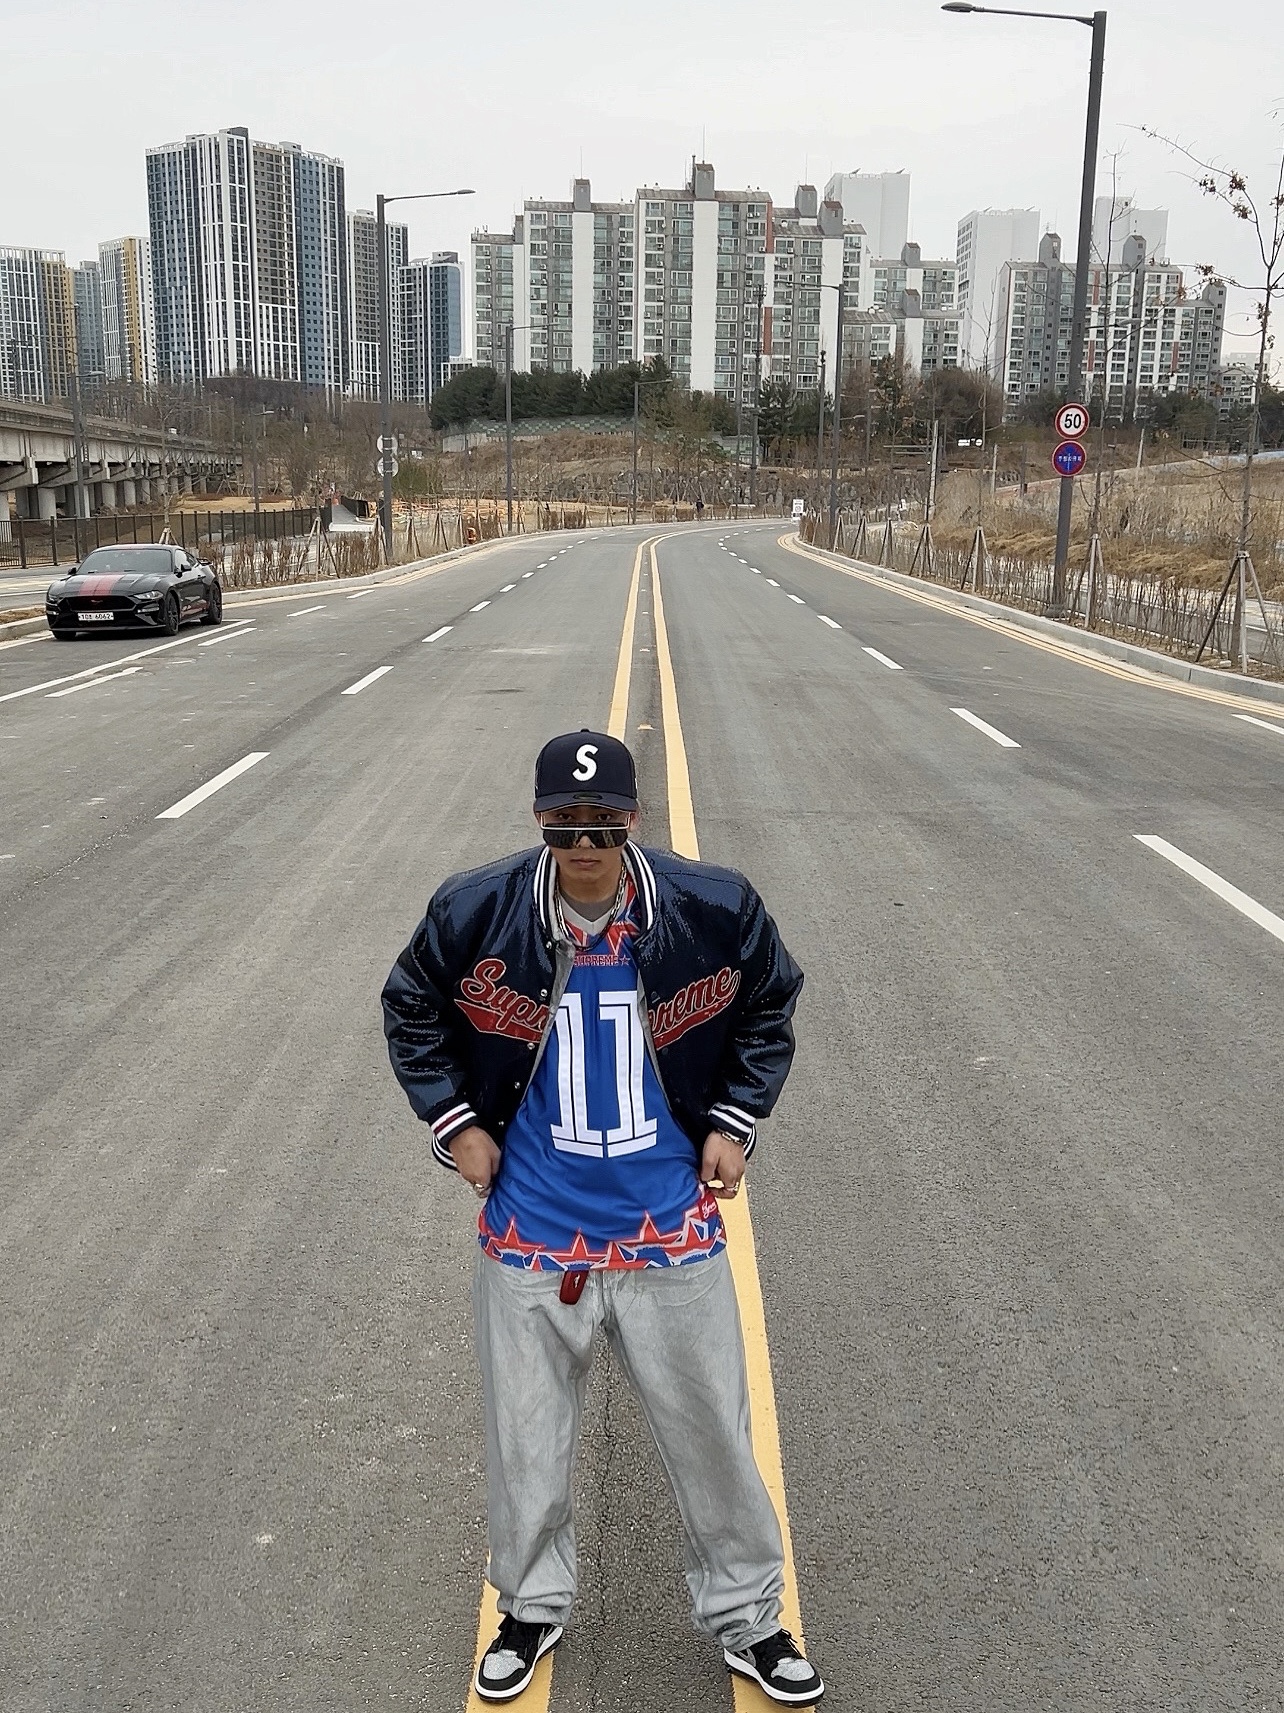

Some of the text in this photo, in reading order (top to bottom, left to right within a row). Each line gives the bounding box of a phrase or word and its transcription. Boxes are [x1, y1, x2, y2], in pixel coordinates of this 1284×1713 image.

[1064, 413, 1081, 429] 50
[572, 744, 599, 781] S
[550, 990, 658, 1158] 11
